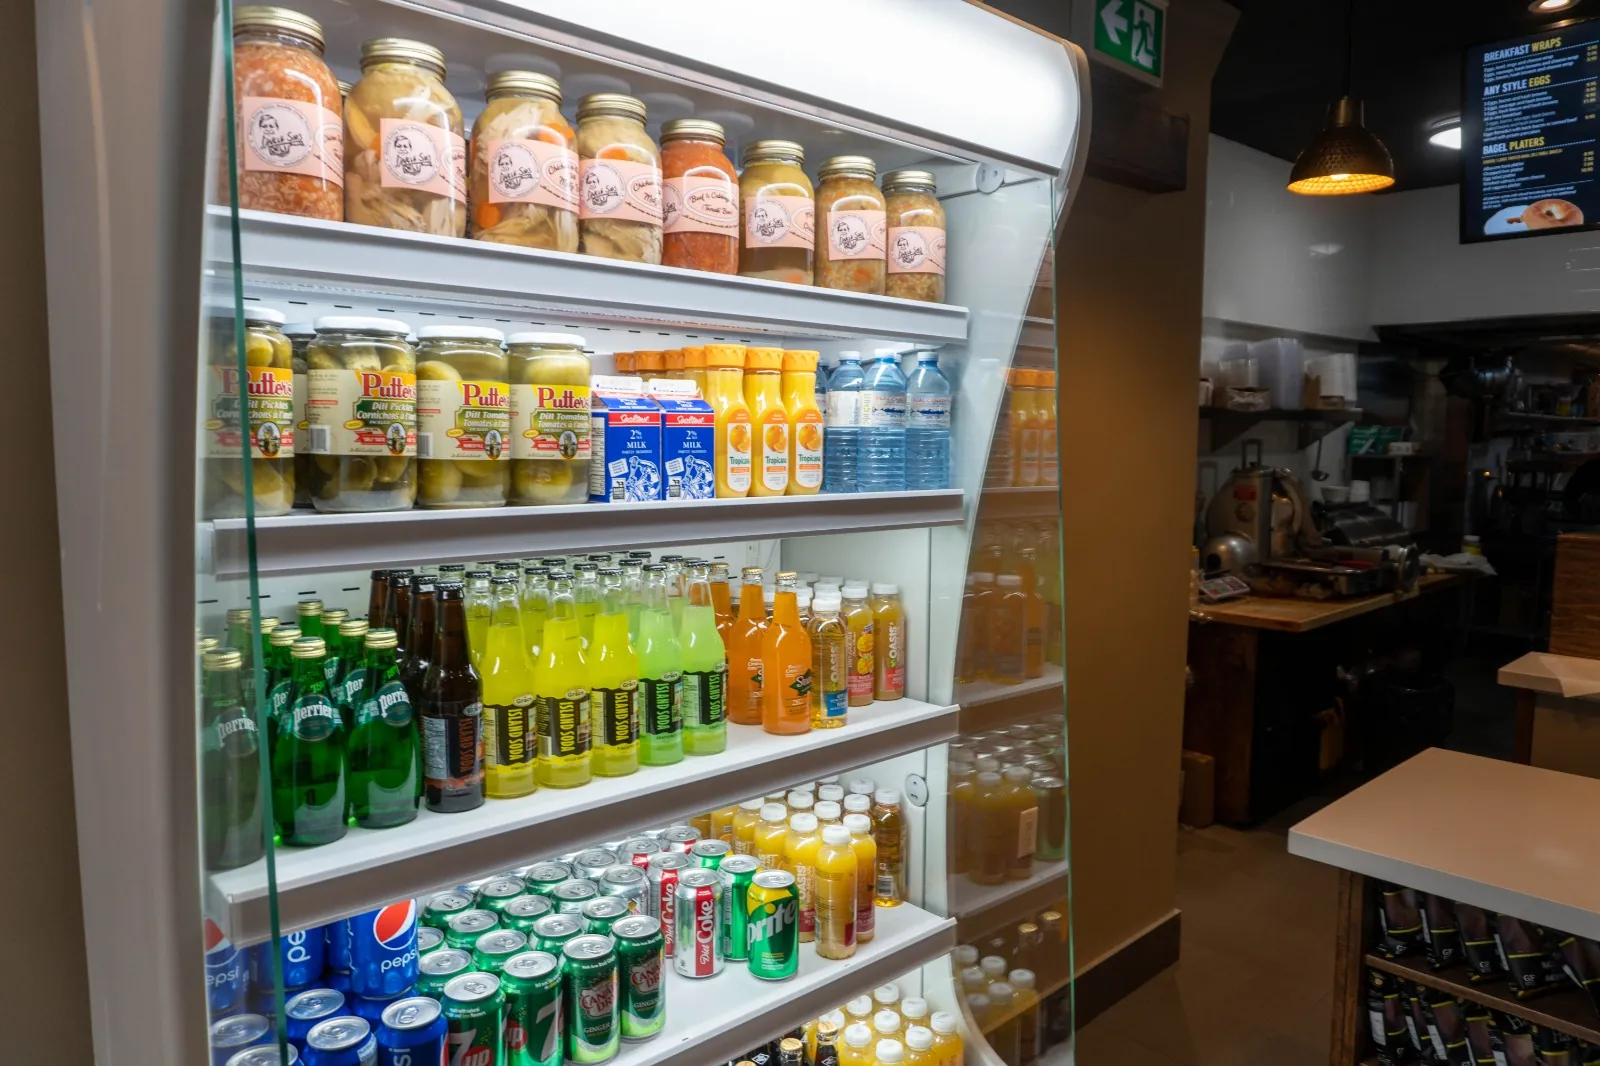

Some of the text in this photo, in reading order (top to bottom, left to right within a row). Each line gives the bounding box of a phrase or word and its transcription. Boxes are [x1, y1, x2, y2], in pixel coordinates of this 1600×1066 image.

[1483, 37, 1562, 62] BREAKFAST WRAPS
[1484, 74, 1551, 96] ANY STYLE EGGS
[1483, 137, 1545, 155] BAGEL PLATERS
[217, 409, 270, 420] Cornchons
[357, 411, 399, 421] Cornichons
[372, 402, 388, 411] Dill
[465, 411, 481, 420] Dill
[540, 412, 589, 421] Dill Tomatoes
[538, 421, 567, 429] Tomates
[889, 625, 897, 659] OASIS
[656, 683, 671, 730] ISLAND SODA
[709, 674, 721, 720] ISLAND SODA
[294, 700, 333, 732] perrier
[559, 701, 576, 752] ISLAND SODA
[614, 692, 630, 741] ISLAND SODA
[507, 708, 524, 761] ISLAND SODA
[697, 899, 714, 965] Diet Coke
[1523, 974, 1536, 982] GF
